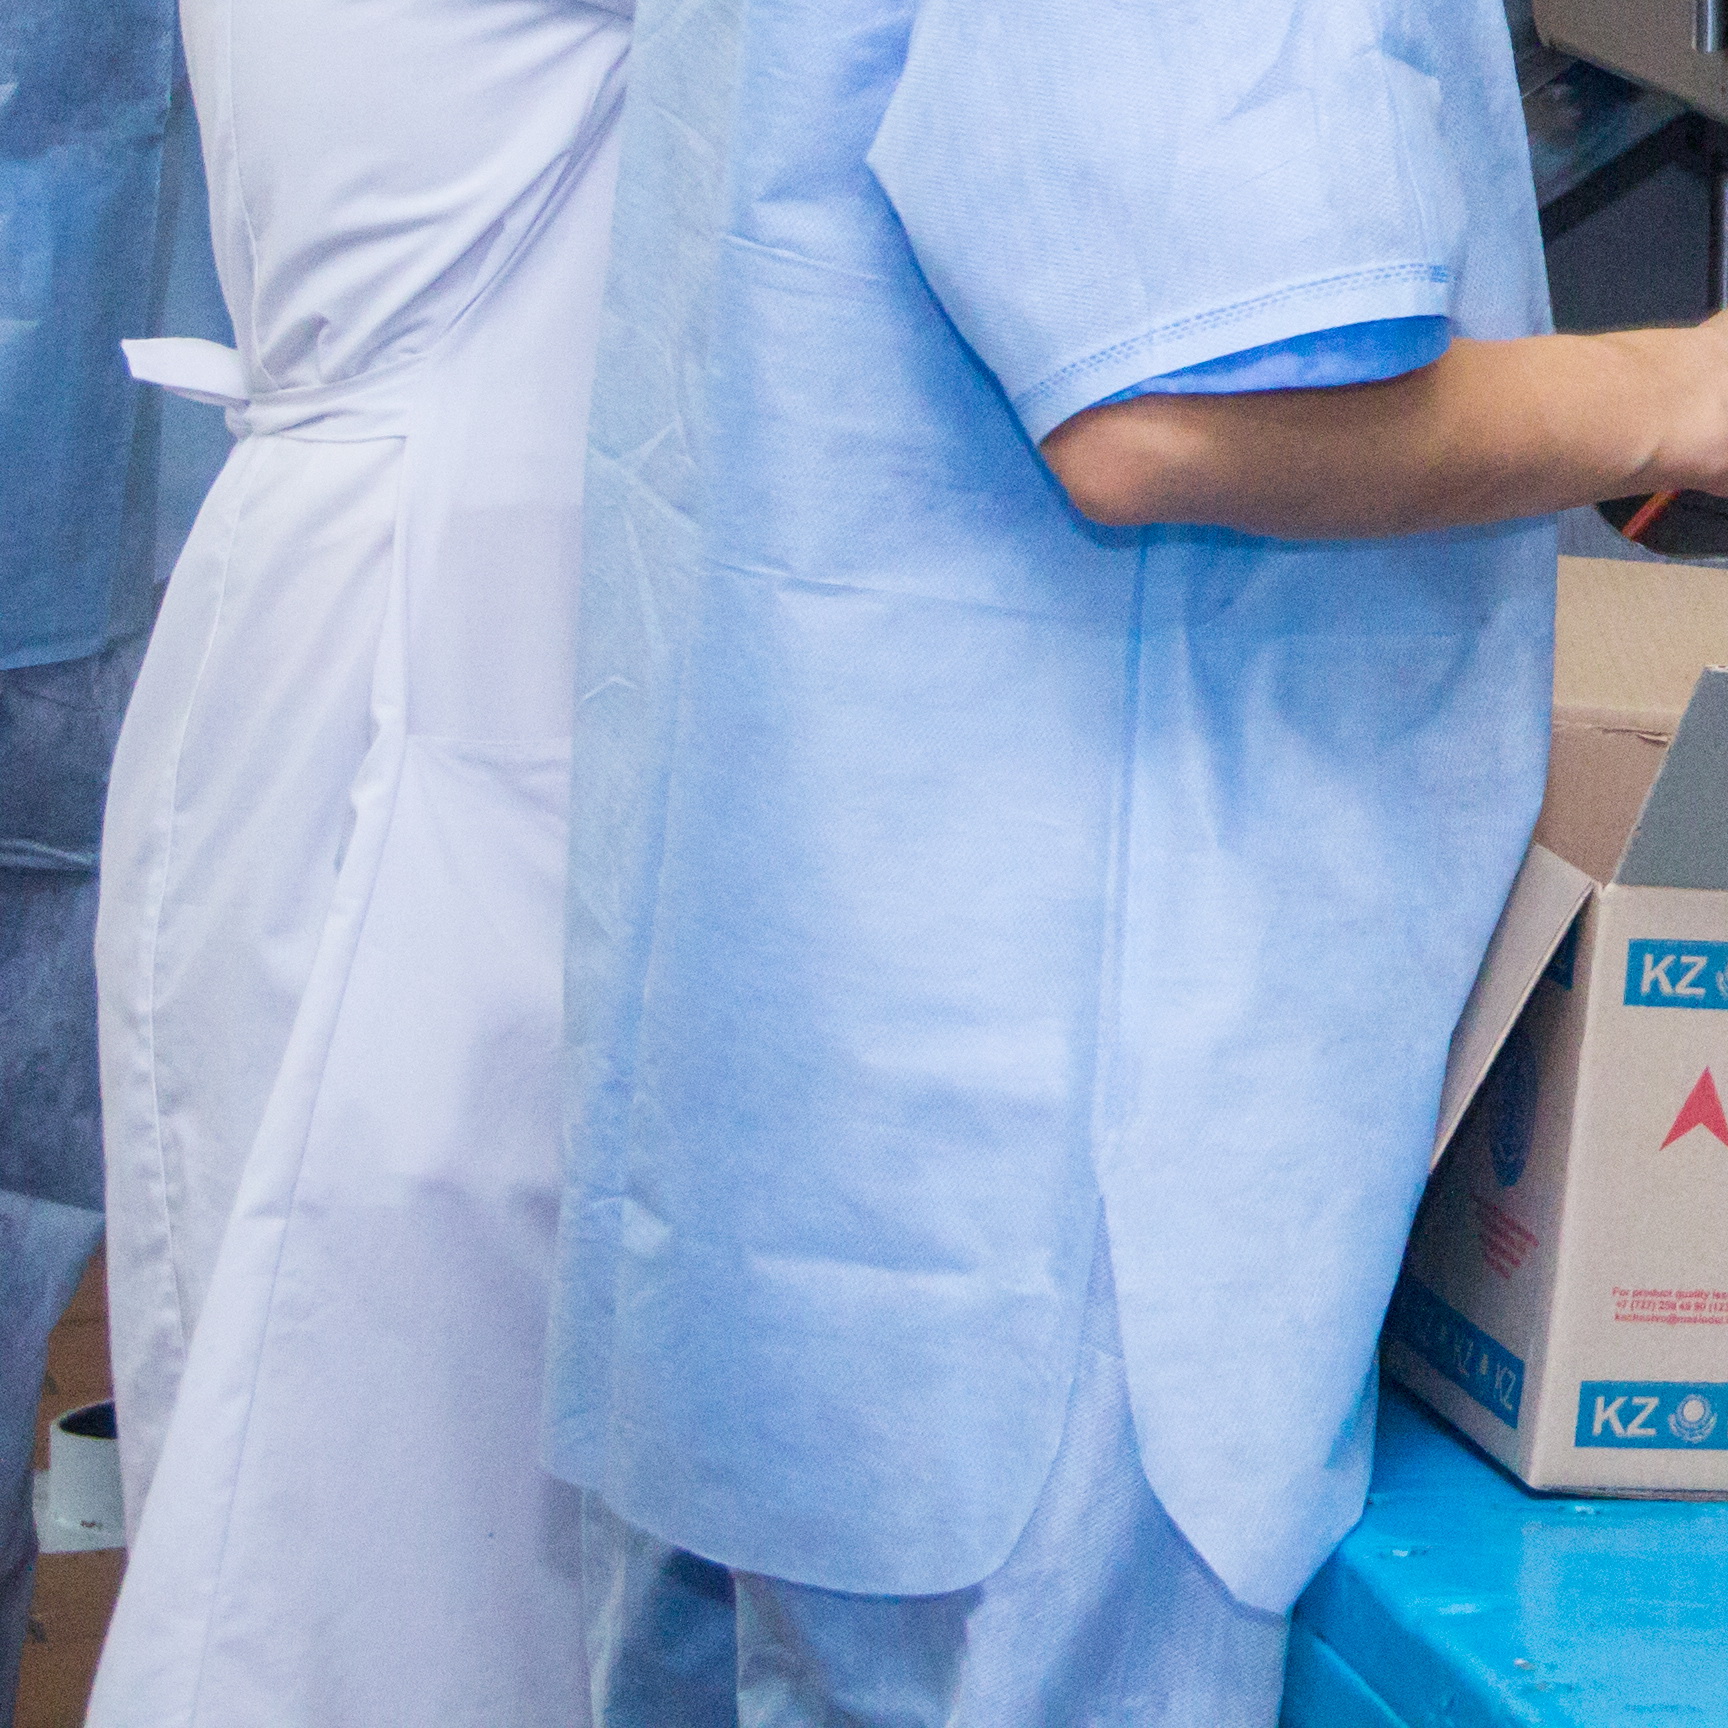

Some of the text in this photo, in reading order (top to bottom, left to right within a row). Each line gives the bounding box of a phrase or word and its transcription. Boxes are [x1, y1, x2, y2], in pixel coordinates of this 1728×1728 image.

[1641, 954, 1708, 996] KZ
[1495, 1362, 1517, 1411] KZ
[1591, 1395, 1660, 1438] KZ
